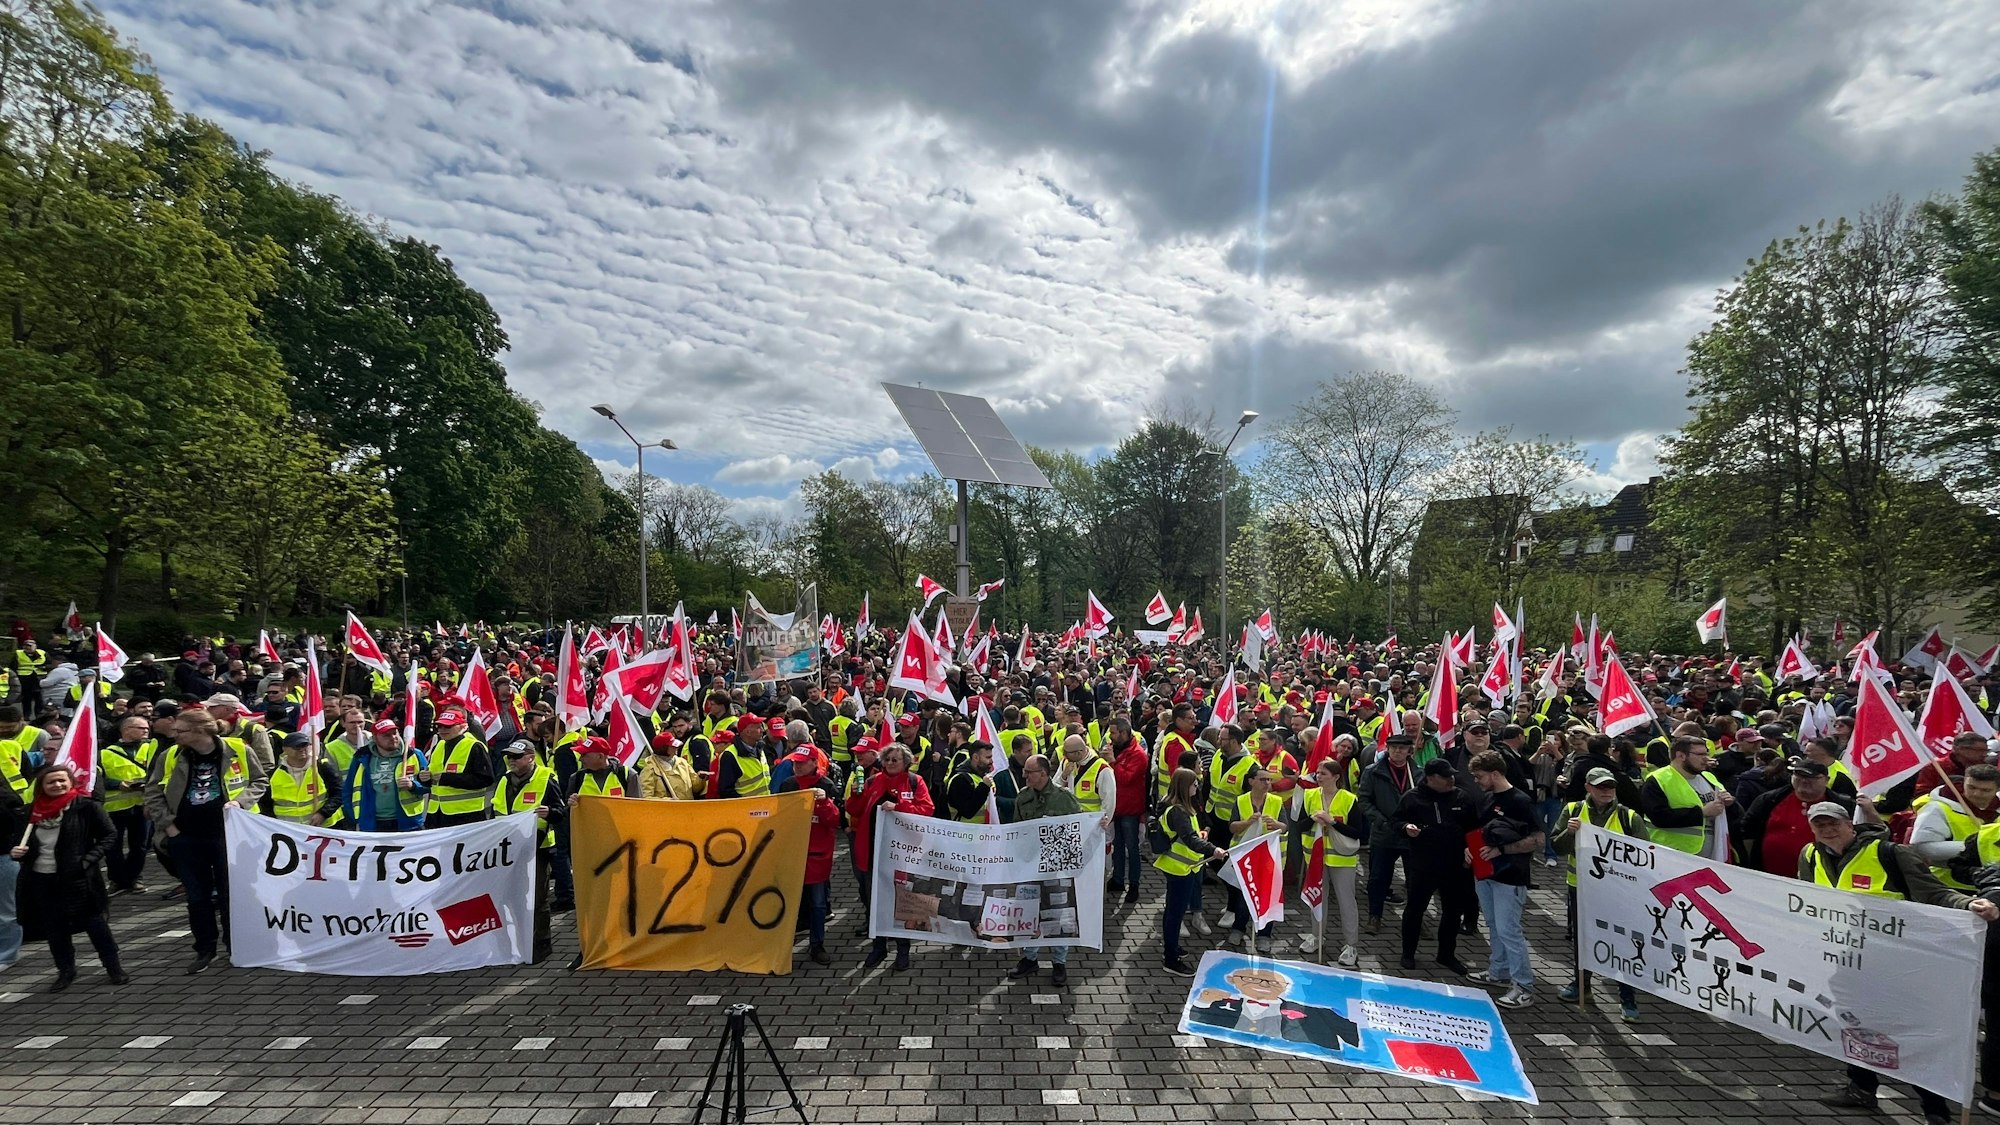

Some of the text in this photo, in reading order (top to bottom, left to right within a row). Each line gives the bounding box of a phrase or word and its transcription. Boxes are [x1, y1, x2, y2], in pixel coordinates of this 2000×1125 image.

[894, 817, 974, 841] Digitalisierung
[979, 832, 1001, 841] ohne
[1006, 831, 1019, 841] IT?
[453, 837, 514, 875] laut
[889, 850, 987, 875] in der Telekom IT!
[890, 839, 1014, 864] Stoppt den Stellenabbau
[593, 827, 787, 937] 12%
[990, 902, 1024, 918] nein
[1788, 893, 1906, 938] Darmstadt
[449, 917, 496, 940] ver.di
[984, 917, 1037, 932] Danke!
[1594, 940, 1833, 1042] Ohne uns geht NIX
[1359, 1000, 1488, 1026] Arbeitgeber wenn
[1399, 1021, 1441, 1034] Miete
[1446, 1030, 1486, 1042] nicht
[1425, 1034, 1484, 1050] können
